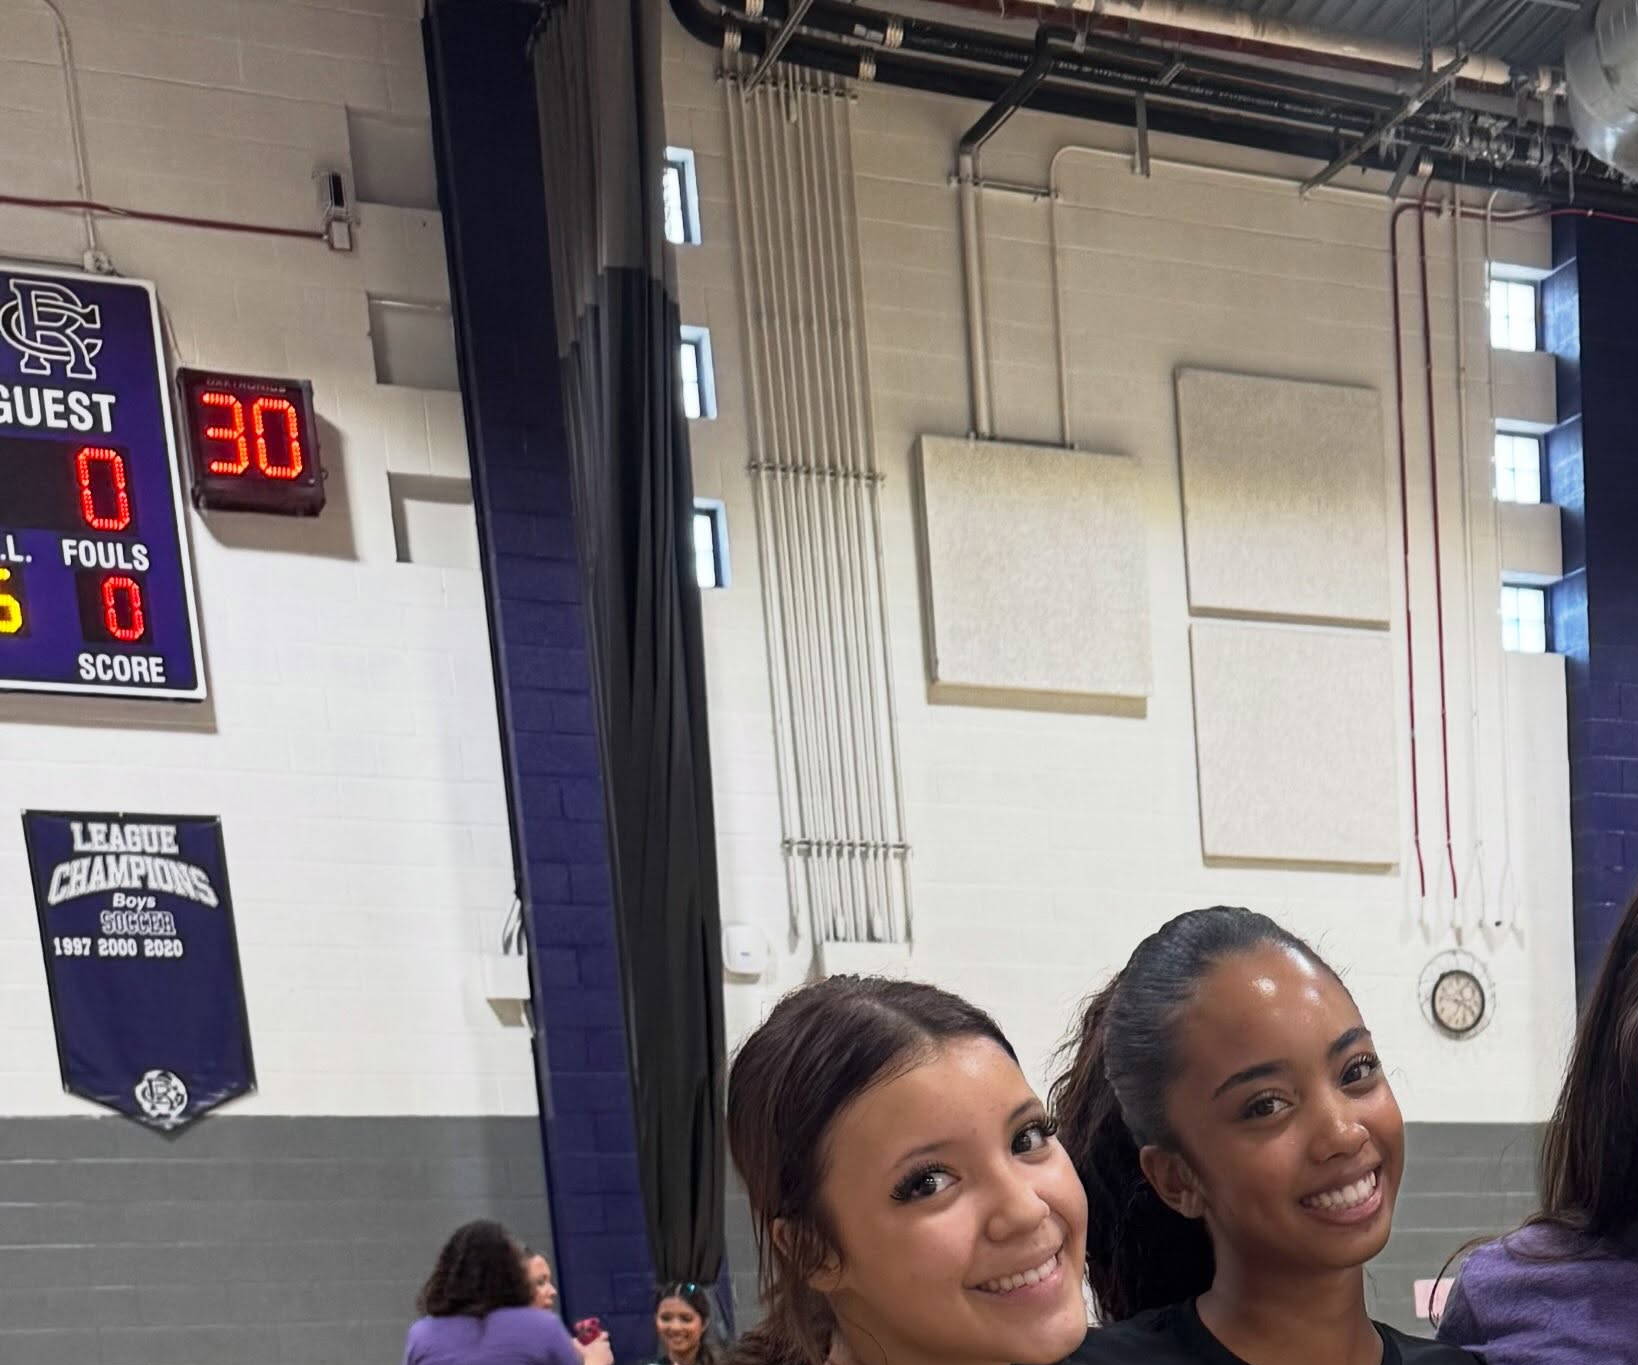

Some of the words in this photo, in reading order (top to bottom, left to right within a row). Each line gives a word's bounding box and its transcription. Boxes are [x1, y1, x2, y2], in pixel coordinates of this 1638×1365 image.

[202, 391, 303, 479] 30
[76, 446, 130, 531] 0
[62, 539, 150, 571] FOULS
[101, 576, 144, 641] 0
[78, 653, 166, 684] SCORE
[70, 822, 179, 855] LEAGUE
[48, 854, 219, 908] CHAMPIONS
[112, 893, 156, 913] Boys
[100, 910, 176, 936] SOCCER
[54, 937, 92, 956] 1997
[98, 938, 138, 957] 2000
[144, 938, 184, 958] 2020
